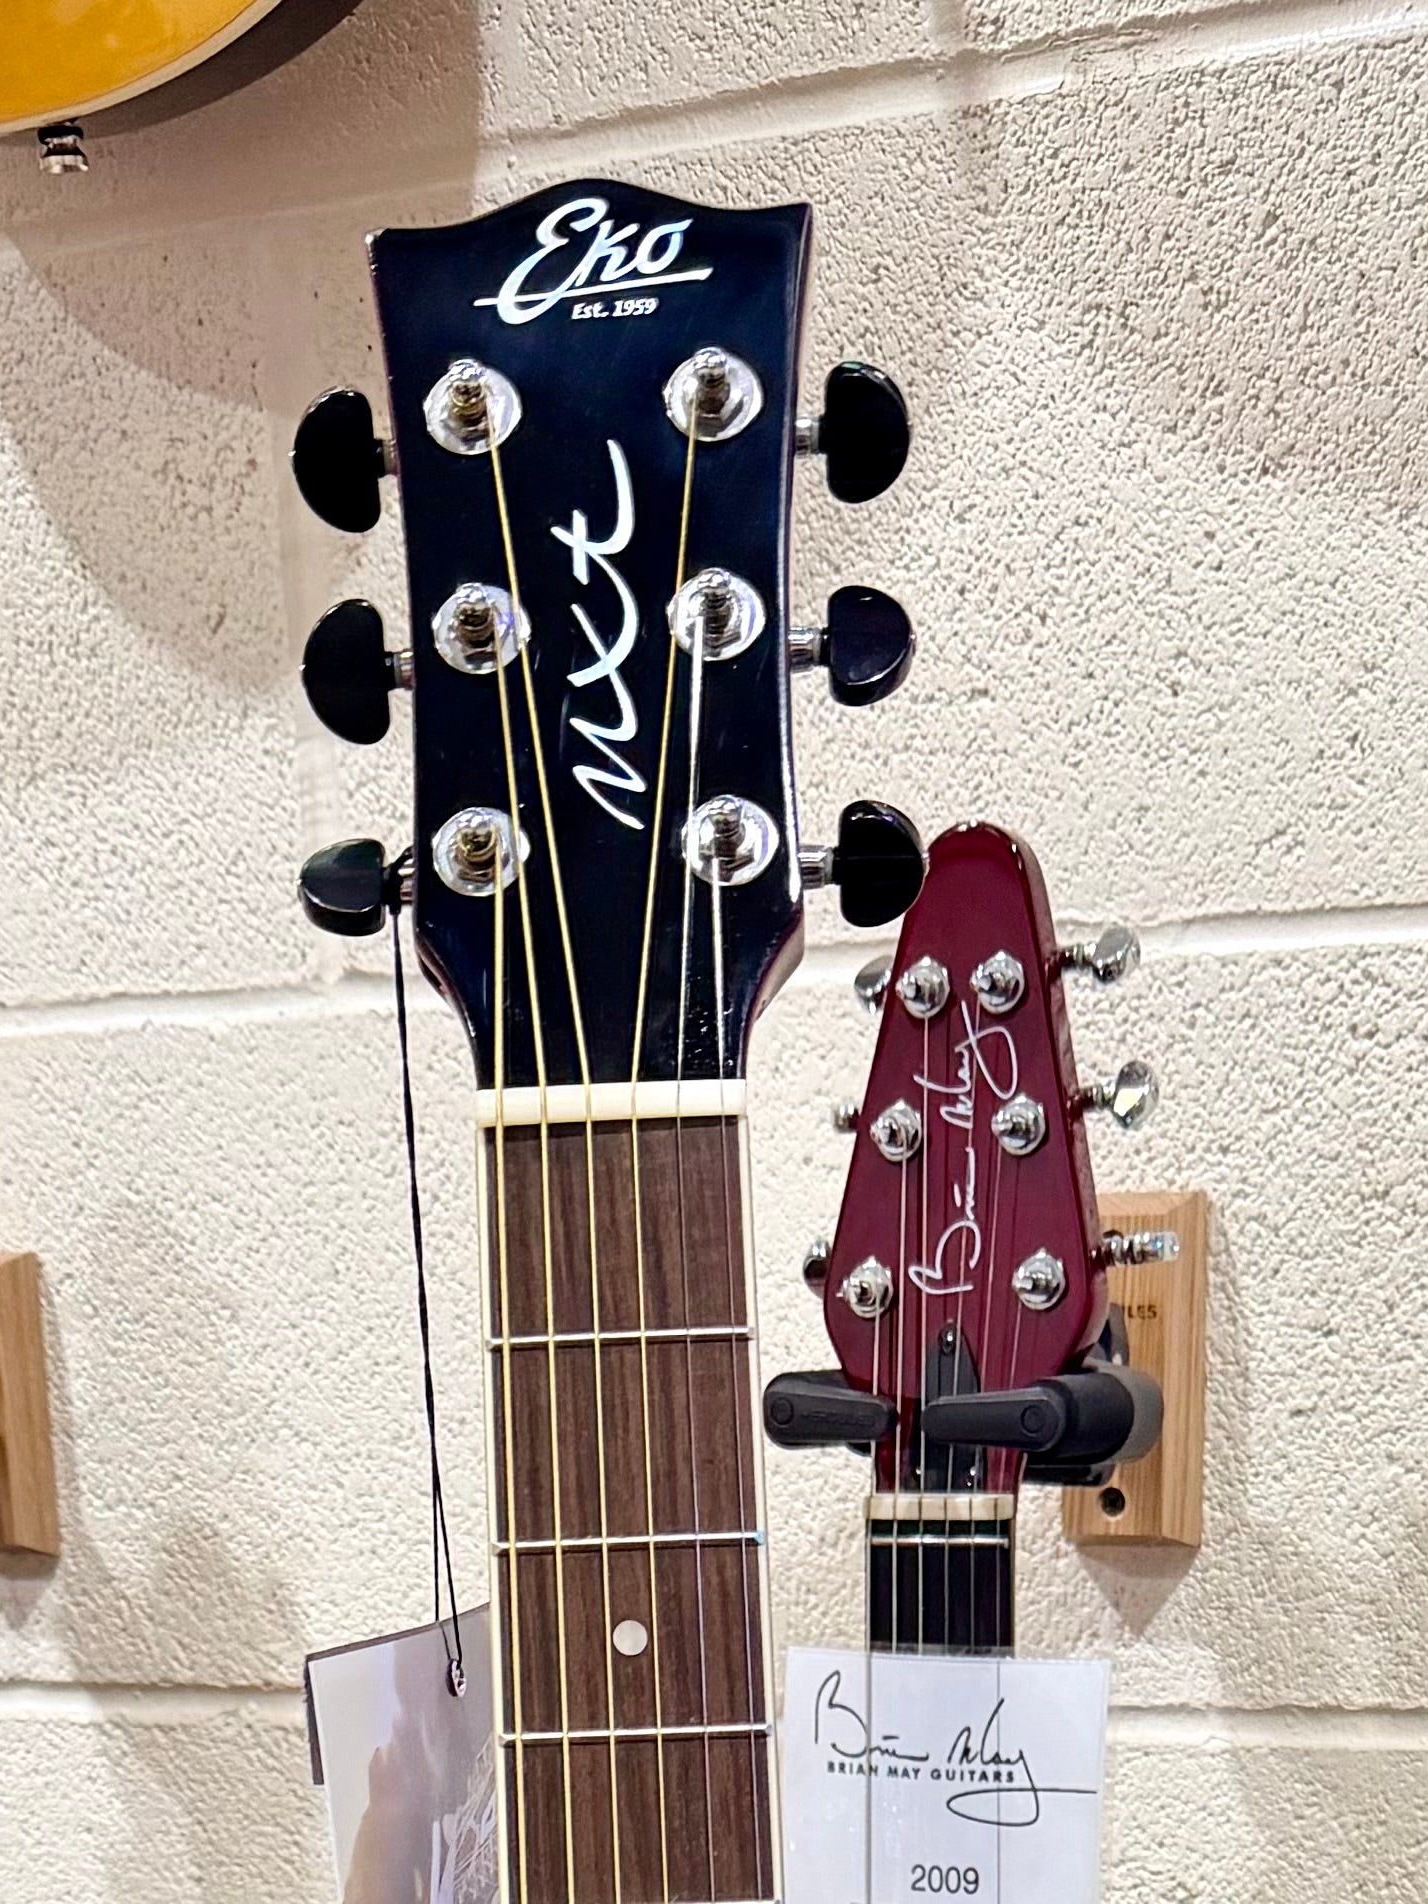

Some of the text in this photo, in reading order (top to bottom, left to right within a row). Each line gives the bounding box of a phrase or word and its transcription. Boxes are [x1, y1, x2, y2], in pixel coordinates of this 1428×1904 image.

[494, 197, 696, 324] Eko
[571, 297, 659, 320] Est. 1959
[826, 1760, 1016, 1785] BRIAN MAY GUITARS
[910, 1864, 980, 1896] 2009
